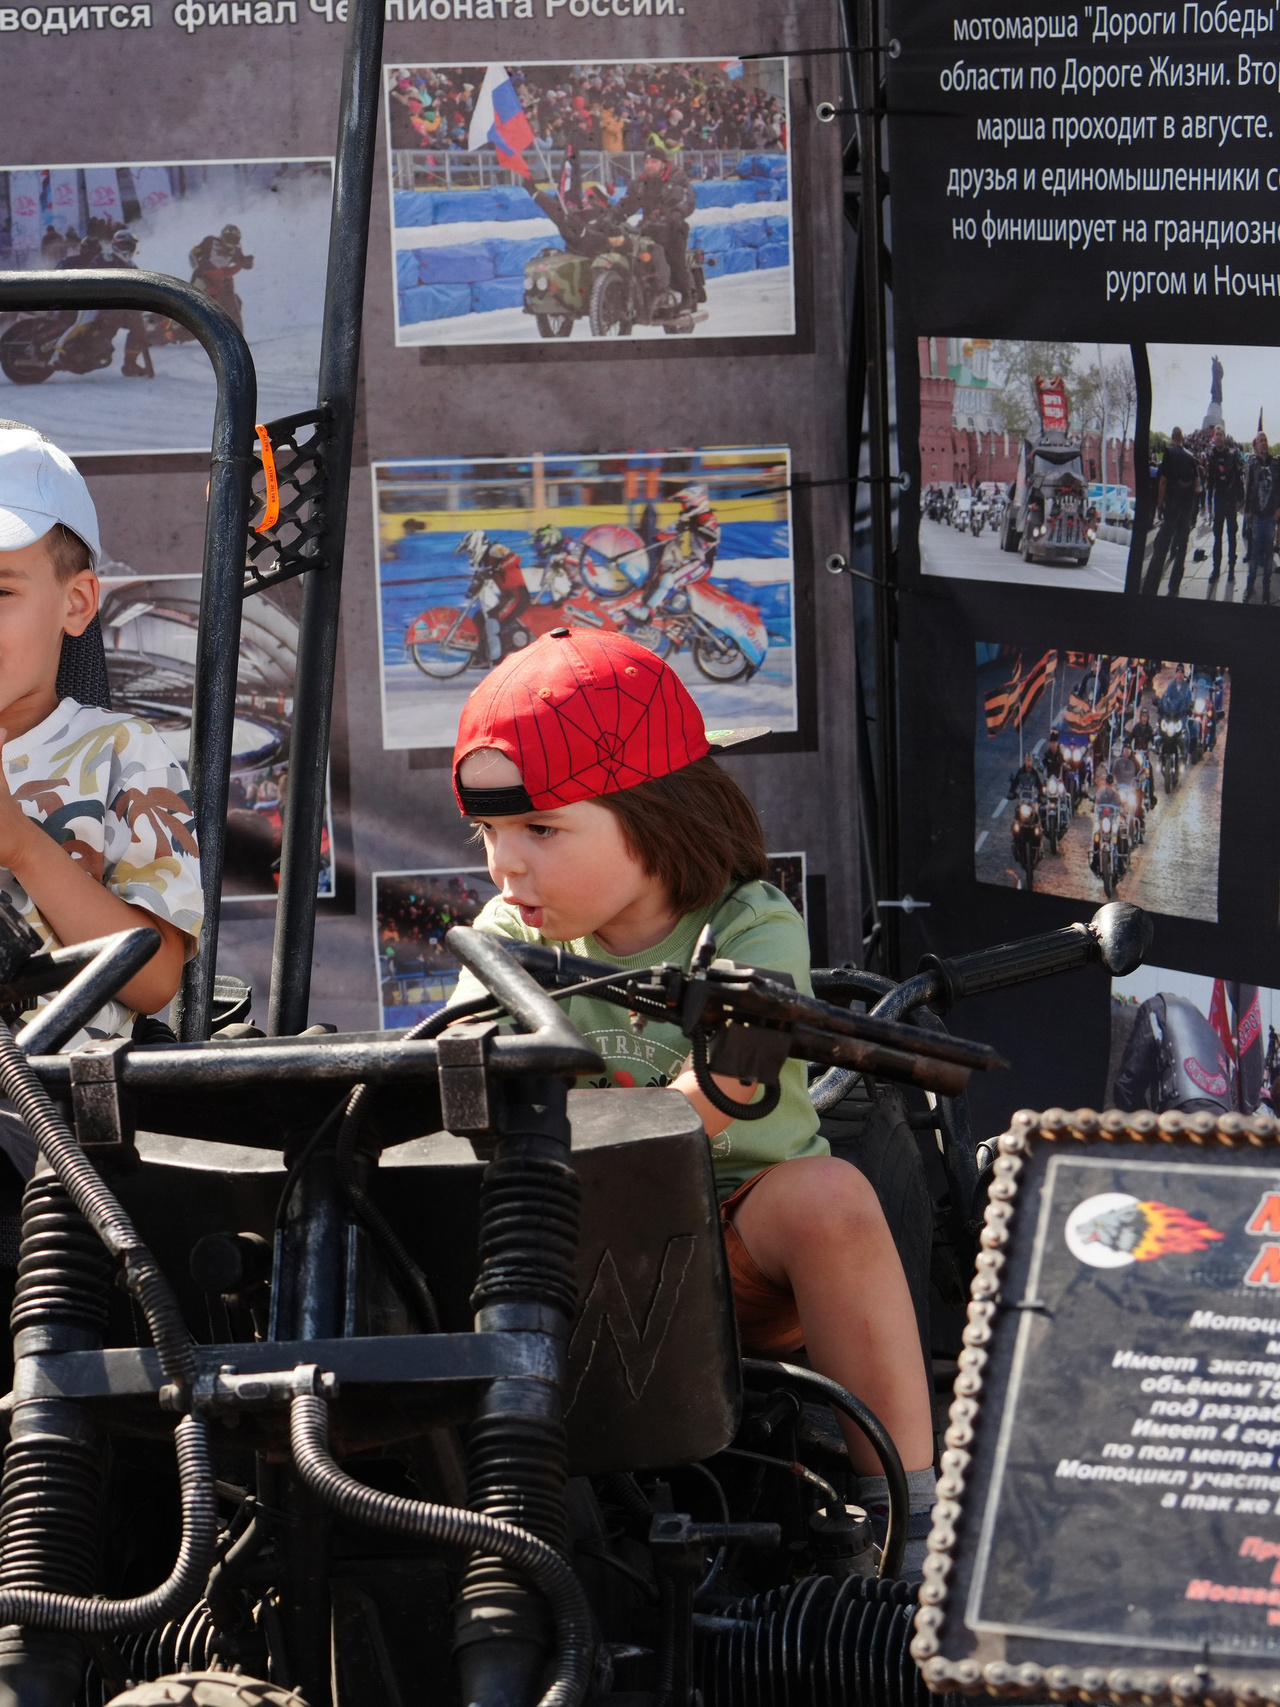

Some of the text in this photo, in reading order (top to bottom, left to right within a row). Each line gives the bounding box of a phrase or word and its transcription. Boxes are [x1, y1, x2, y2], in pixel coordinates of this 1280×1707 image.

[173, 0, 299, 34] финал
[309, 0, 534, 23] Чепионата
[546, 0, 687, 19] России.
[953, 14, 1078, 47] мотомарша
[1084, 5, 1176, 44] "Дороги
[940, 53, 1280, 97] области по Дороге Жизни. Вто
[977, 114, 1273, 148] марша проходит в августе.
[946, 167, 1280, 199] друзья и единомышленники с
[952, 209, 1280, 251] но финиширует на грандиозн
[1106, 264, 1280, 302] рургом и Ночн
[596, 1035, 656, 1064] TREE
[1111, 1349, 1198, 1373] Имеет
[1140, 1374, 1253, 1399] объёмом
[1149, 1397, 1200, 1418] под
[1130, 1416, 1219, 1441] Имеет
[1220, 1423, 1240, 1443] 4
[1101, 1442, 1136, 1461] по
[1137, 1444, 1187, 1462] пол
[1188, 1445, 1274, 1471] метра
[1055, 1458, 1188, 1486] Мотоцикл
[1160, 1492, 1178, 1509] а
[1180, 1493, 1234, 1512] так
[1234, 1497, 1272, 1515] же
